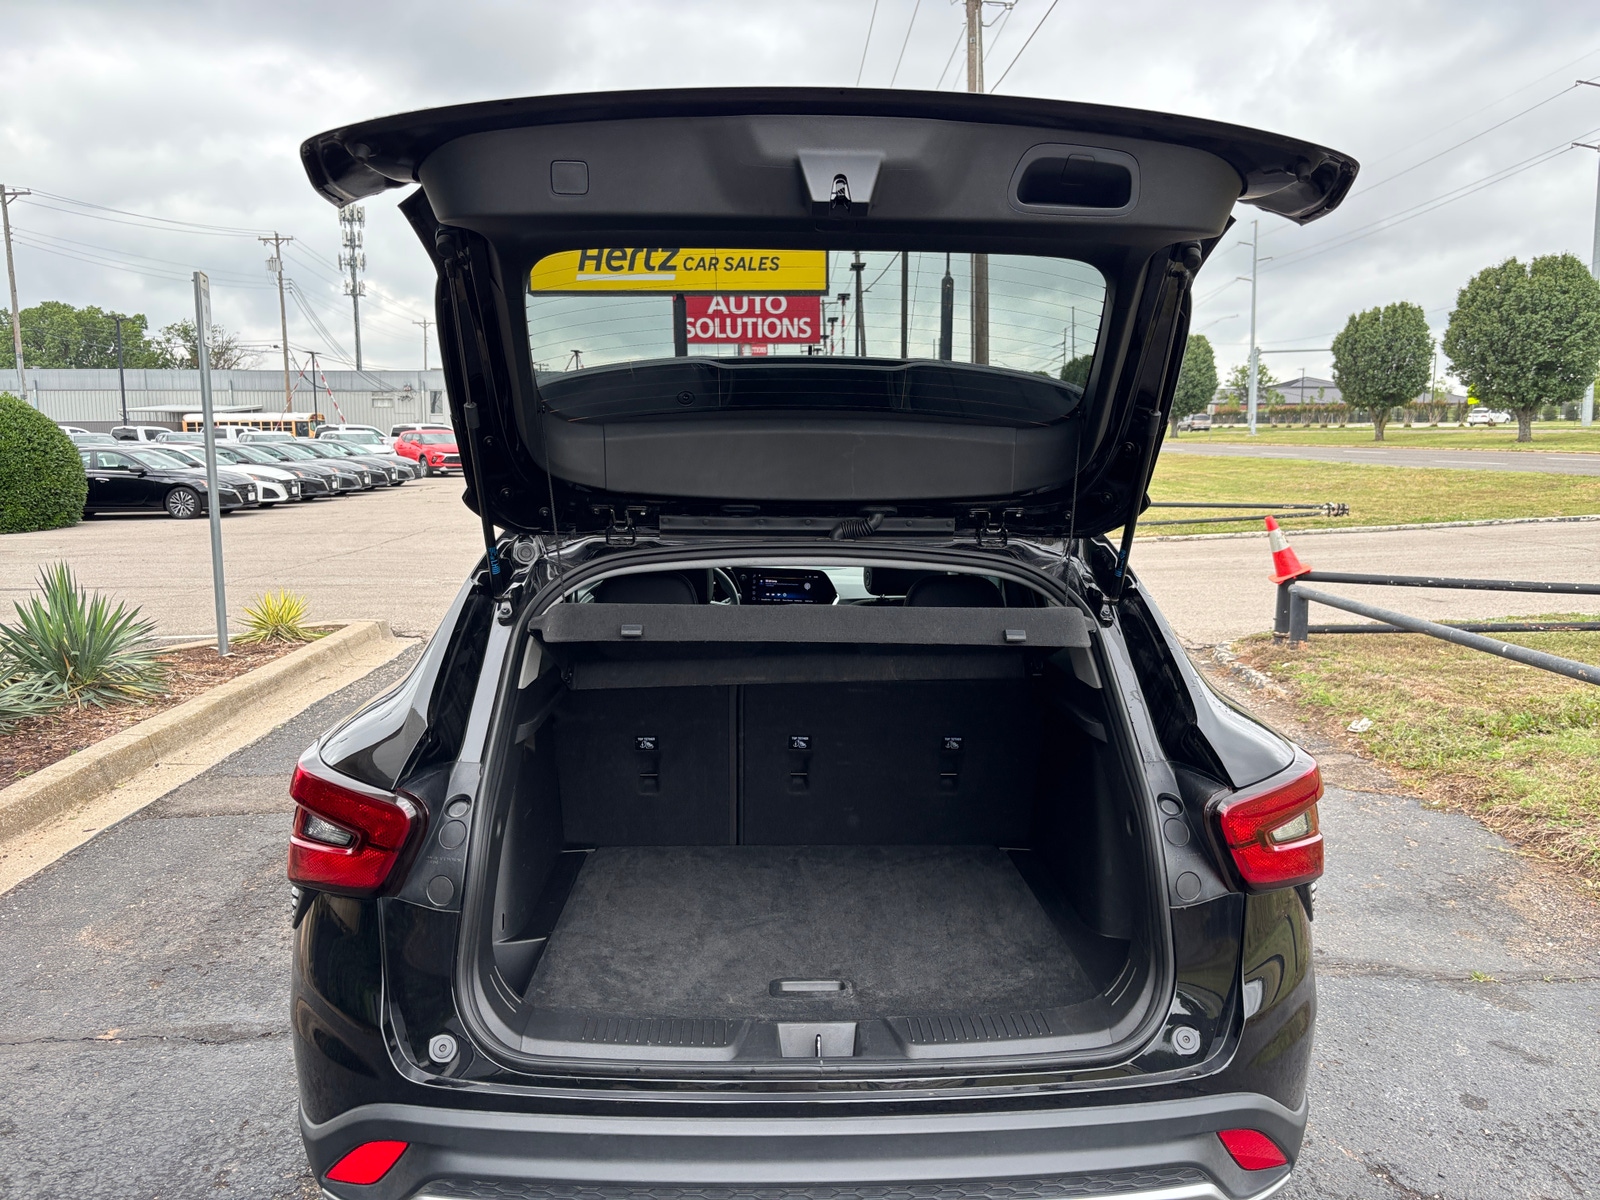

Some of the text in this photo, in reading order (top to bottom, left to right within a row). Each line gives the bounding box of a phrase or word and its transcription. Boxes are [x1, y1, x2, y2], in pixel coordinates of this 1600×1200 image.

[578, 248, 780, 271] Hertz CAR SALES
[707, 296, 788, 315] AUTO
[686, 317, 812, 339] SOLUTIONS
